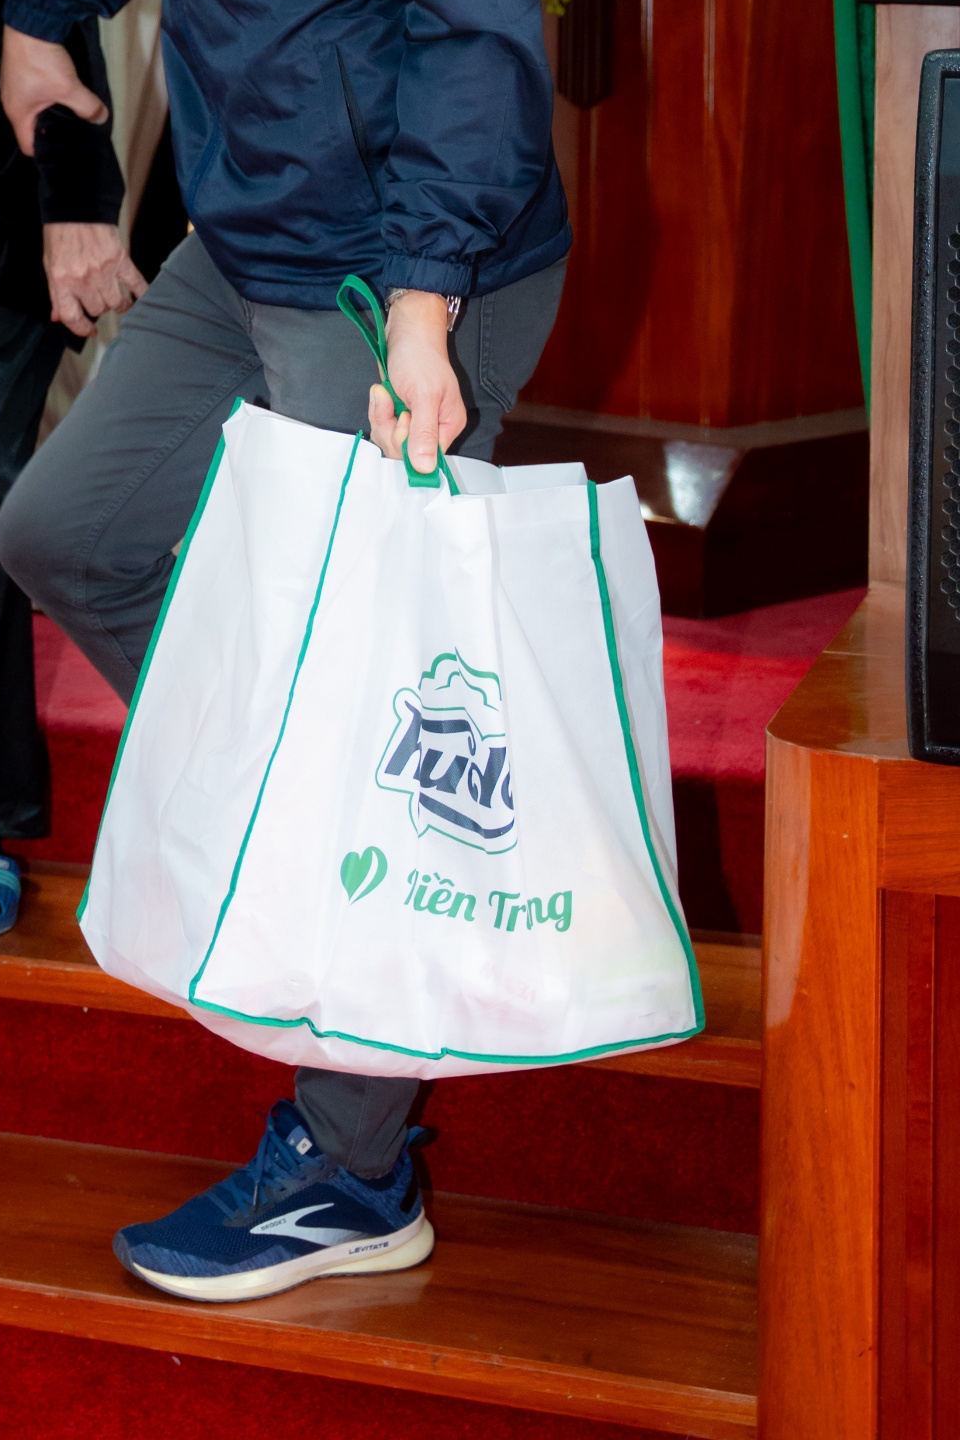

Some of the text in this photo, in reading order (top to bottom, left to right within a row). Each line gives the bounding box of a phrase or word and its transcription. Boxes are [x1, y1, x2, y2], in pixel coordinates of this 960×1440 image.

[488, 890, 573, 933] Trng
[261, 1218, 287, 1232] BROOKS
[349, 1241, 390, 1255] LEVITATE
